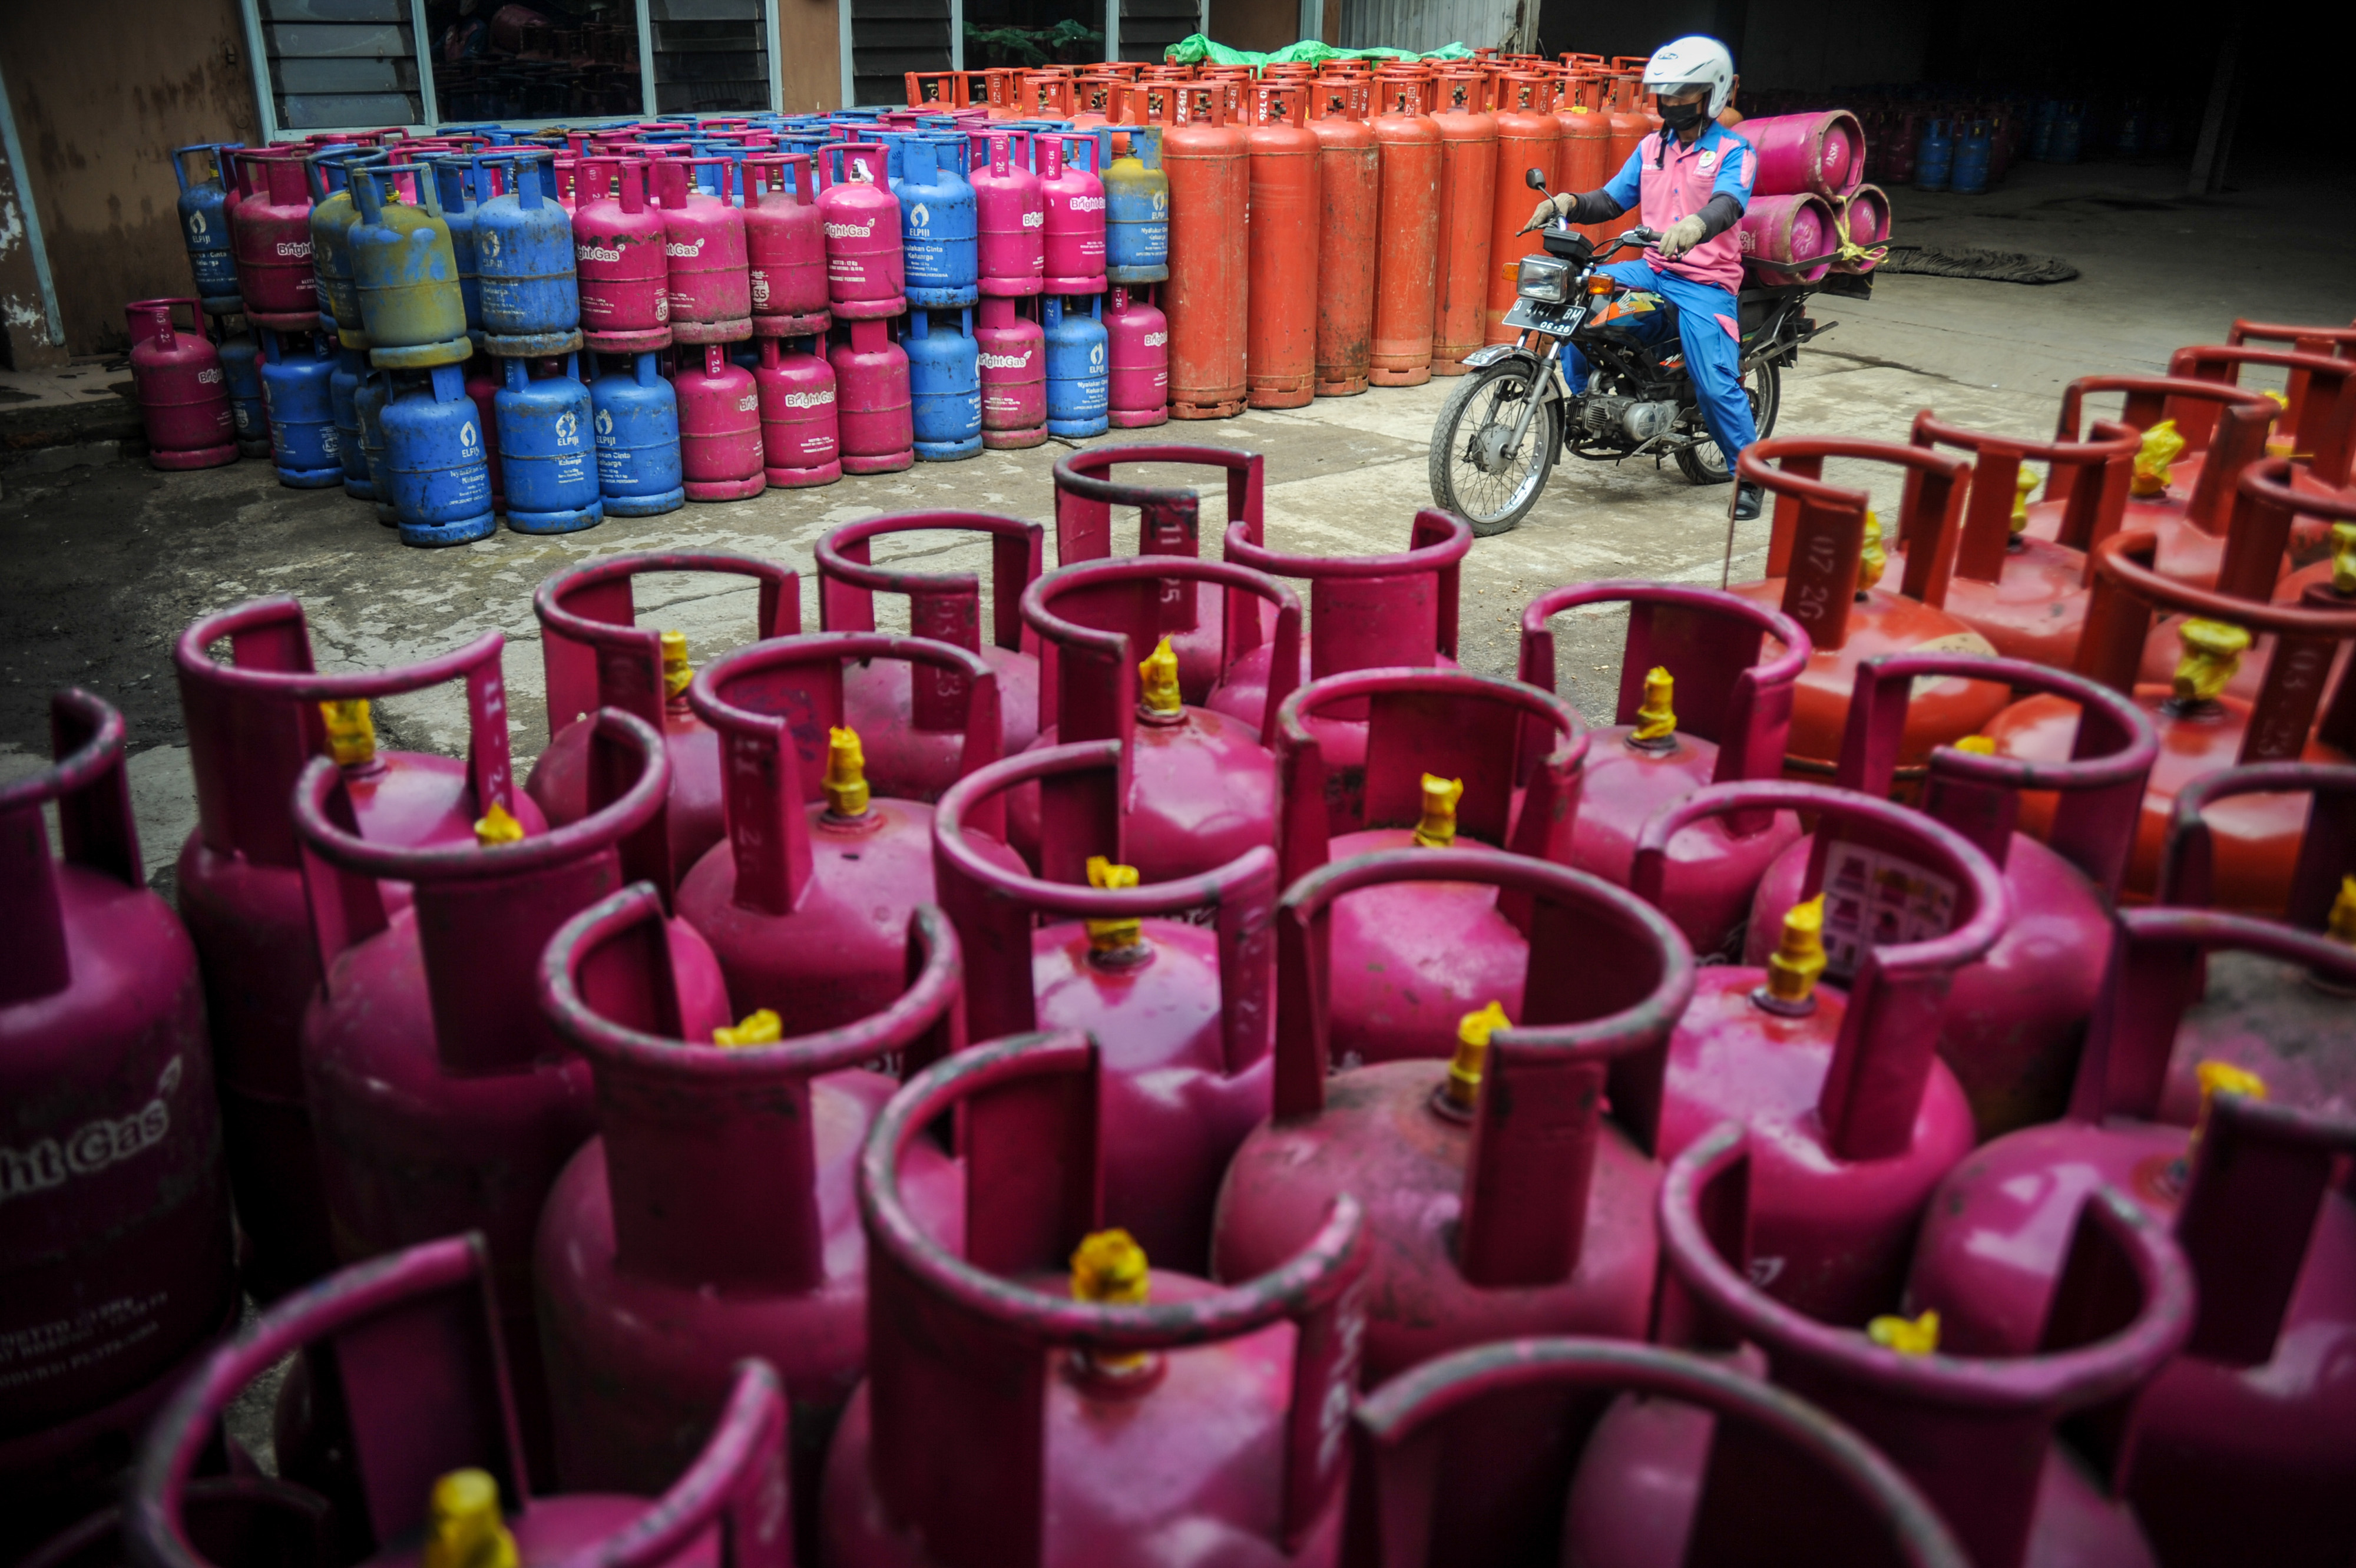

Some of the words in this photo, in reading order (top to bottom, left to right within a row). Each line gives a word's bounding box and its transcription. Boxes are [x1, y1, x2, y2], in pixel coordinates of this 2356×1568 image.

[1071, 197, 1097, 211] Bright
[825, 223, 847, 238] right
[848, 224, 870, 237] Gas
[595, 247, 619, 261] Gas
[675, 243, 699, 256] Gas
[1513, 300, 1523, 311] D
[1562, 308, 1581, 320] BM
[979, 353, 1004, 369] right
[1004, 356, 1026, 368] Gas
[786, 392, 819, 408] Bright
[67, 1098, 170, 1176] Gas
